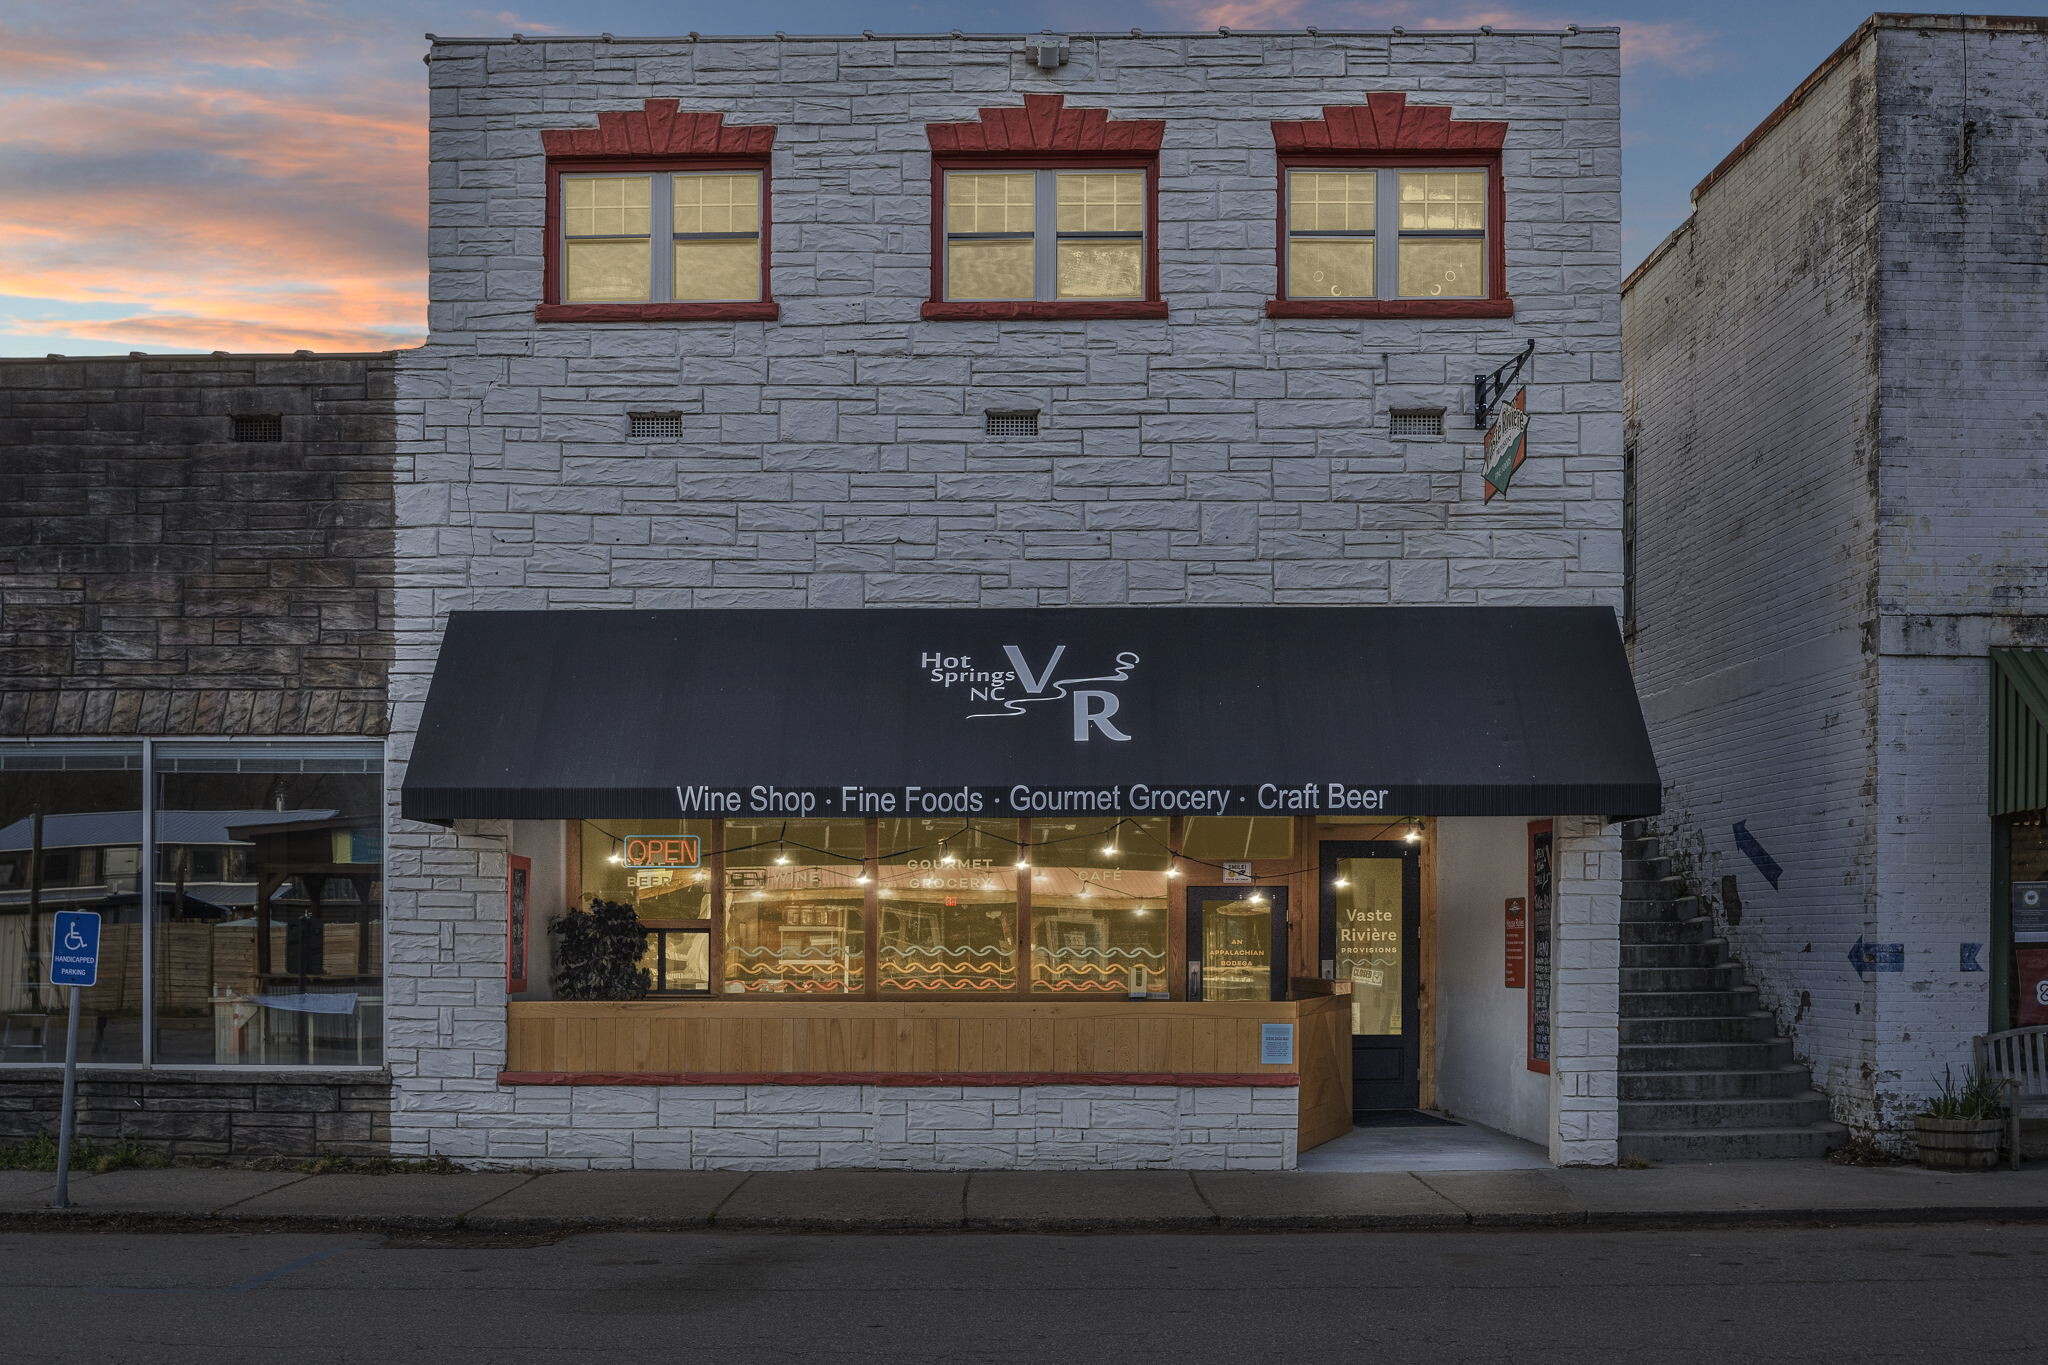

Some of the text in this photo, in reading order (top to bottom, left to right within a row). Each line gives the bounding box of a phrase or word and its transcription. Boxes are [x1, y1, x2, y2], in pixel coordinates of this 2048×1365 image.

[921, 652, 971, 668] Hot
[1003, 645, 1066, 693] V
[931, 668, 1016, 687] Springs
[971, 687, 1006, 701] NC
[1074, 690, 1132, 742] R
[677, 783, 1389, 817] Wine Shop Fine Foods Gourmet Grocery Craft Beer
[628, 839, 697, 863] OPEN
[907, 859, 993, 870] GOURMET
[774, 872, 819, 882] WINE
[1078, 867, 1122, 881] CAFÉ
[627, 876, 671, 888] BEER
[909, 878, 991, 888] GROCERY
[1346, 908, 1392, 921] Vaste
[1341, 928, 1397, 941] Rivière
[55, 955, 94, 964] HANDICAPPED
[61, 968, 86, 976] PARKING
